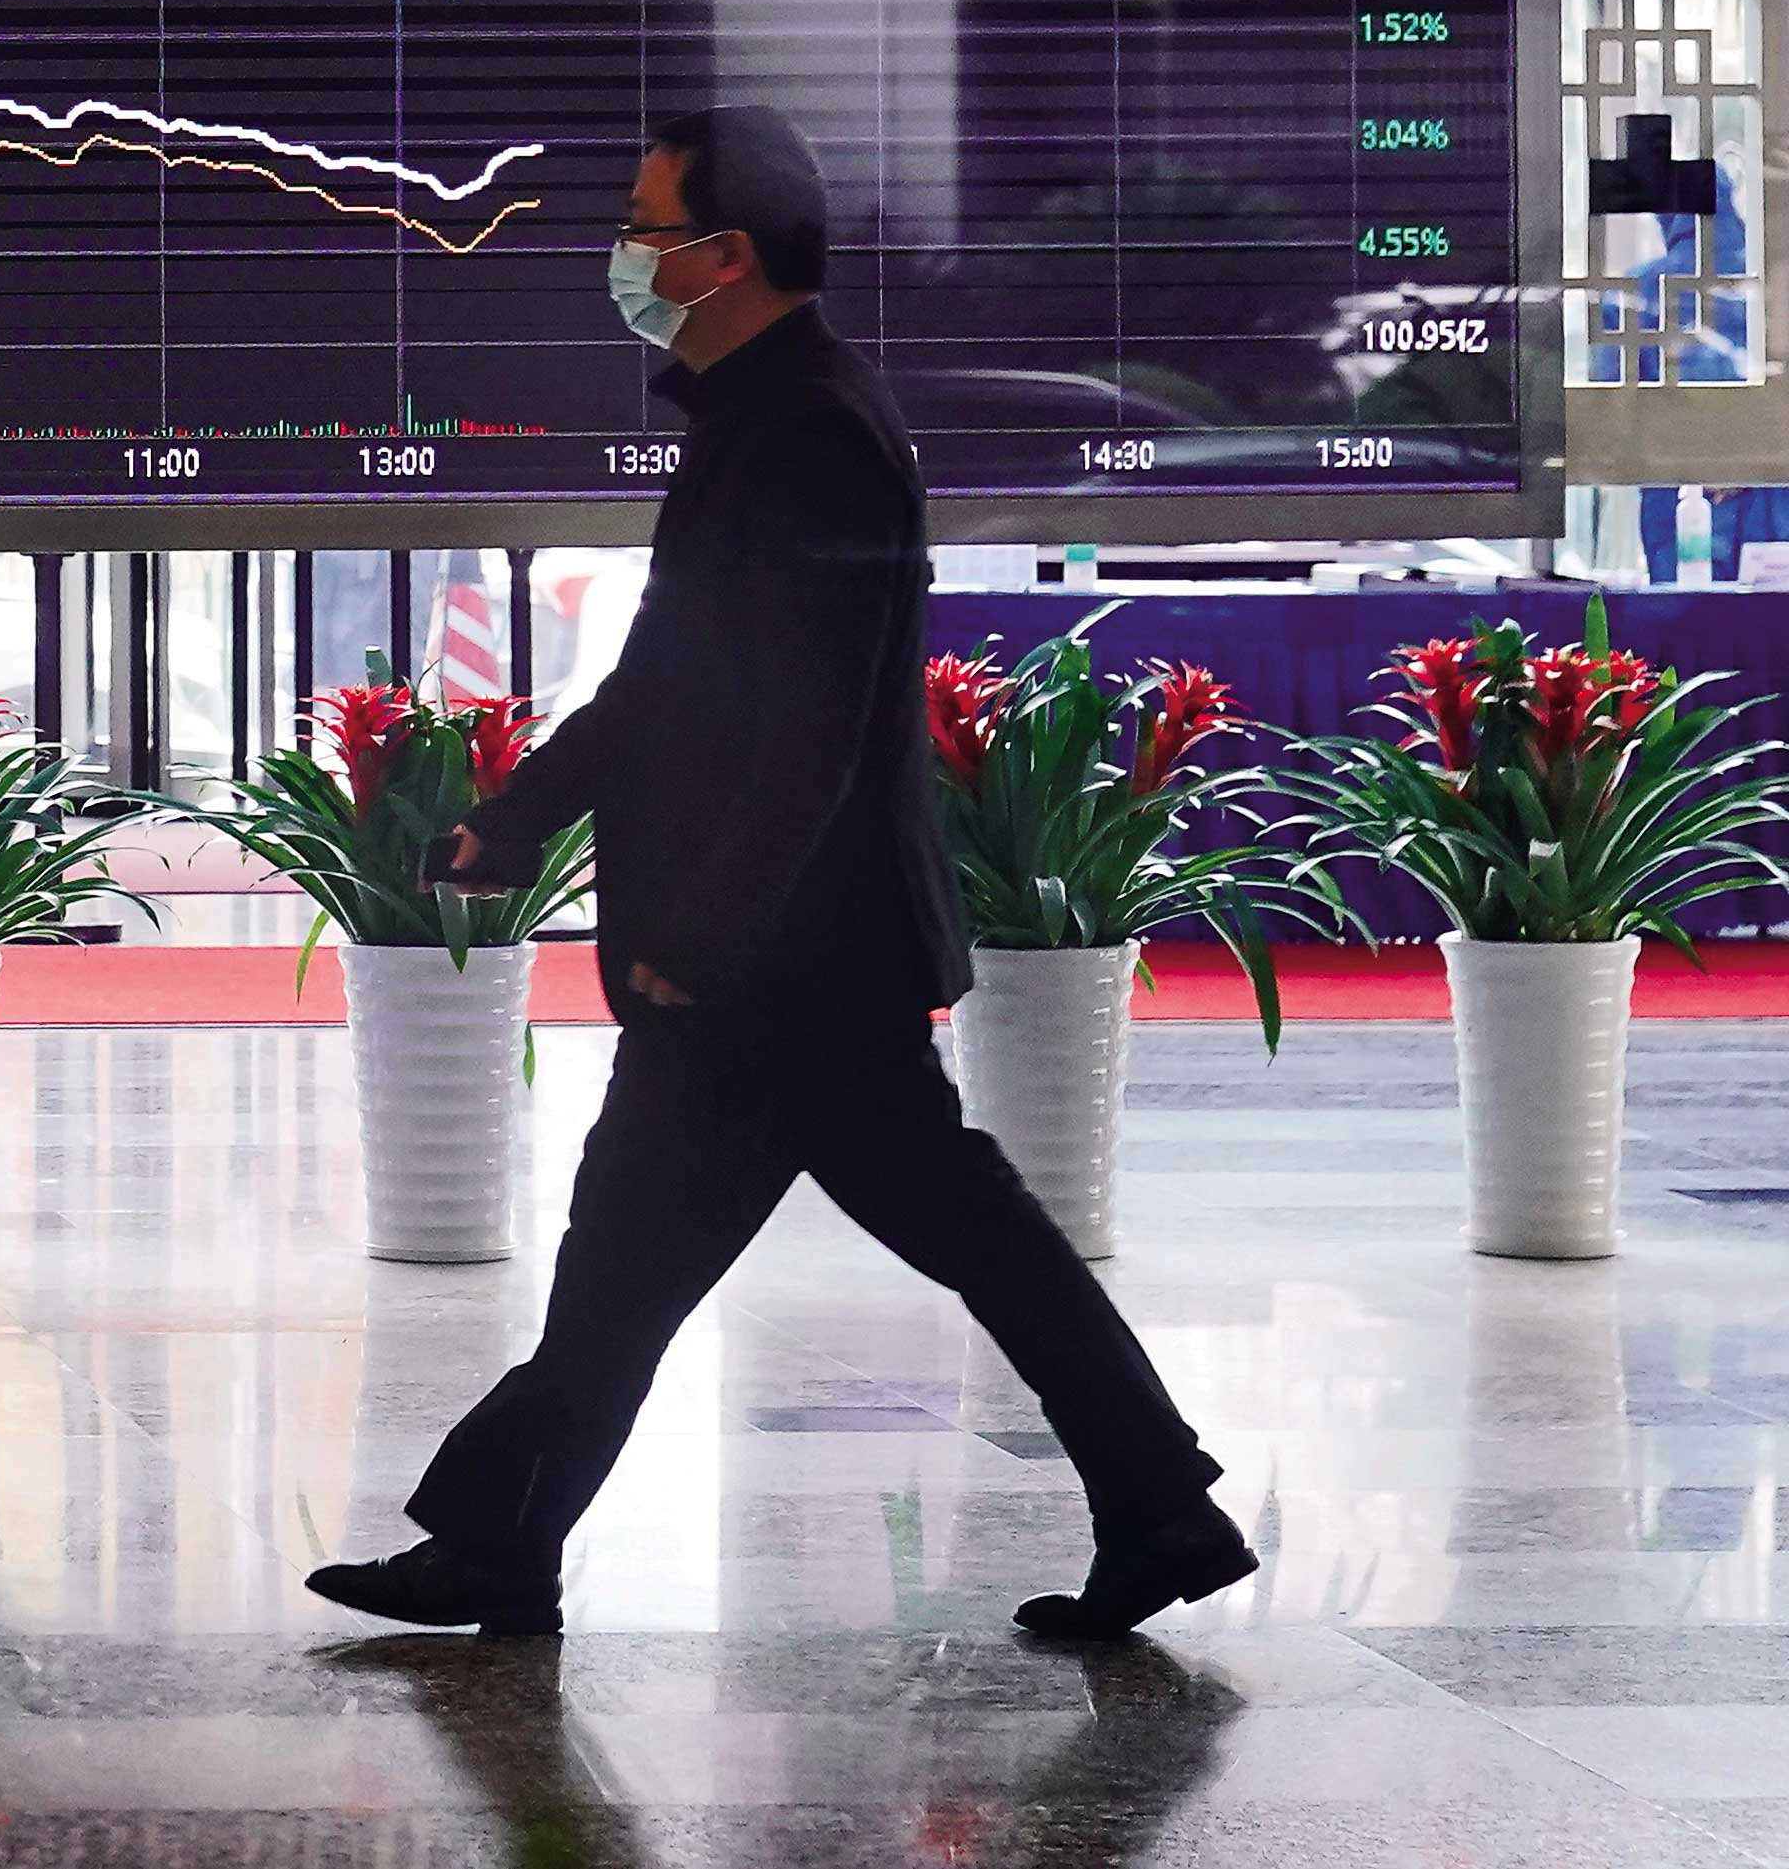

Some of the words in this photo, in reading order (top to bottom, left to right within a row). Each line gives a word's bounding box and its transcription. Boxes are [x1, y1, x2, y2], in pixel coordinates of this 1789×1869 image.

[1361, 12, 1448, 41] 1.52%
[1362, 119, 1449, 149] 3.04%
[1360, 227, 1448, 256] 4.55%
[1363, 318, 1488, 352] 100.95亿
[124, 448, 199, 477] 11:00
[359, 446, 434, 475] 13:00
[605, 445, 680, 474] 13:30
[1080, 440, 1155, 470] 14:30
[1316, 437, 1392, 467] 15:00
